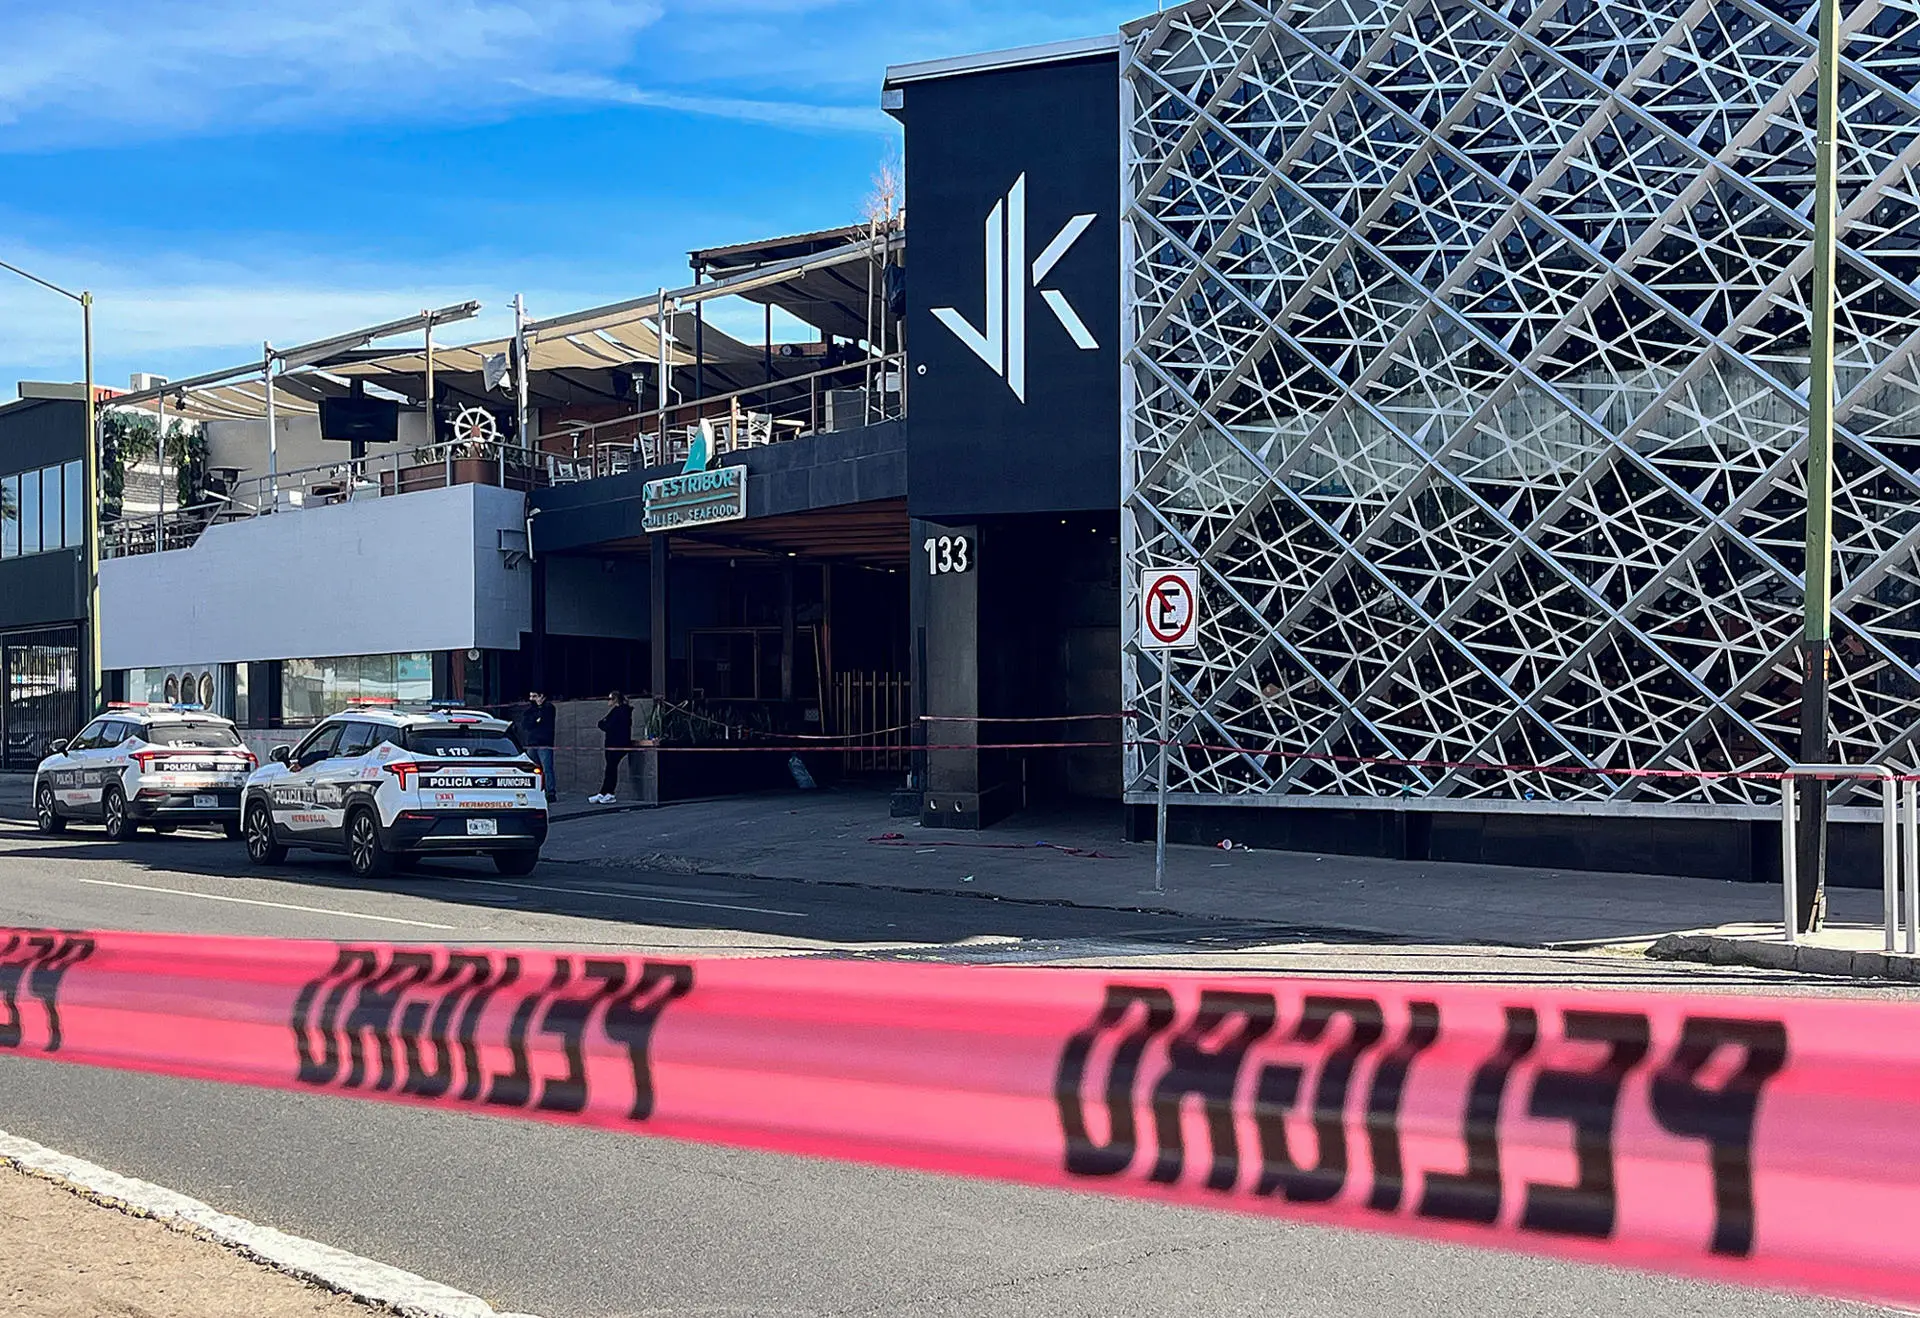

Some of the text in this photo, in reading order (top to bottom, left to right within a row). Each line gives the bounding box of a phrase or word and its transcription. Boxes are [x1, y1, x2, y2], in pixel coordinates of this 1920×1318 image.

[660, 469, 735, 498] ESTRIBOR
[687, 503, 735, 519] SEAFOOD
[923, 535, 968, 575] 133
[436, 748, 446, 756] E
[163, 762, 198, 771] POLICÍA
[430, 775, 531, 787] POLICÍA MUNICIPAL
